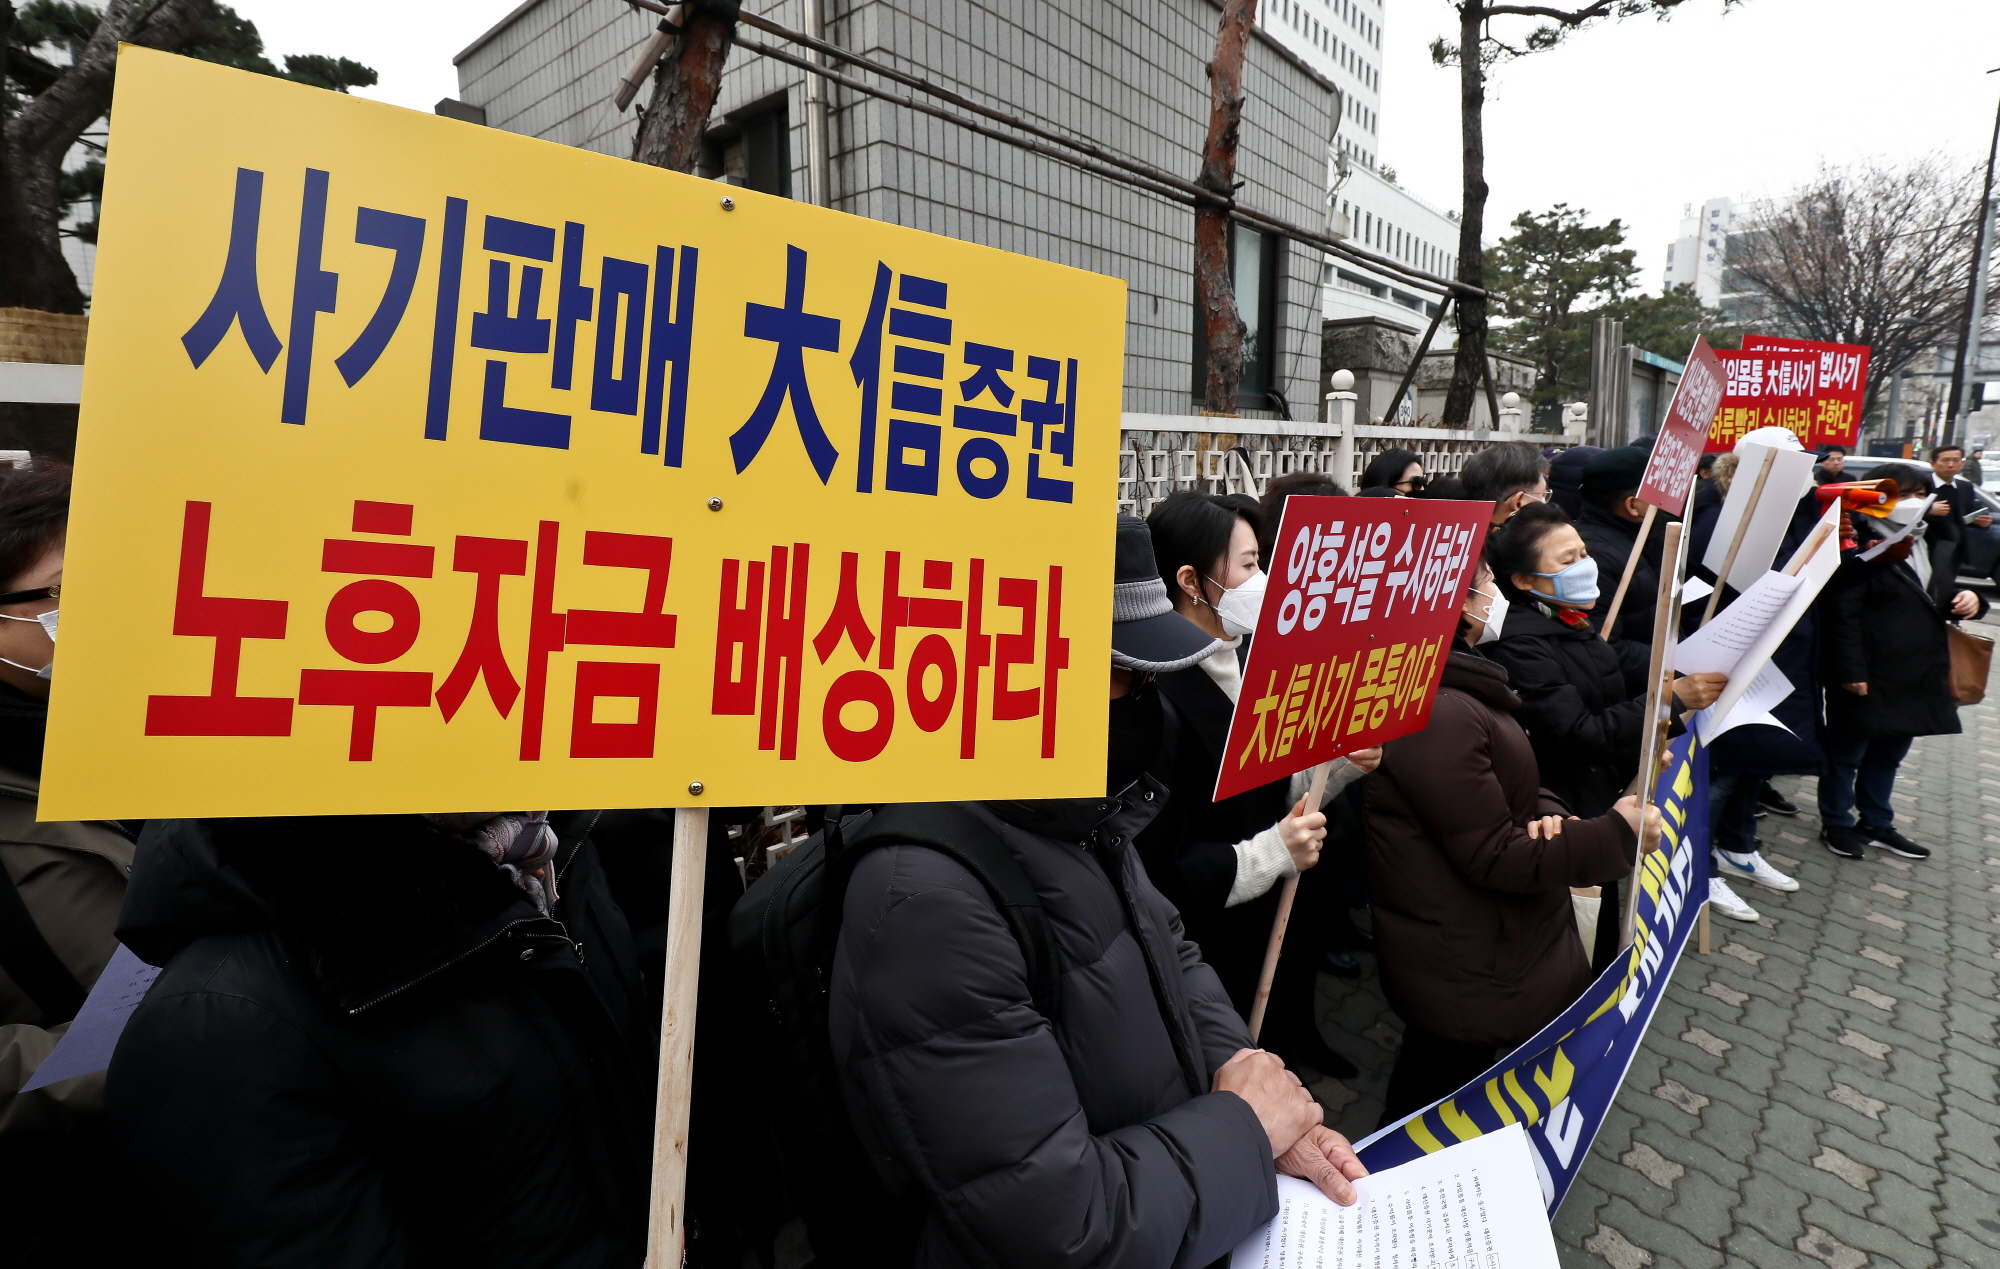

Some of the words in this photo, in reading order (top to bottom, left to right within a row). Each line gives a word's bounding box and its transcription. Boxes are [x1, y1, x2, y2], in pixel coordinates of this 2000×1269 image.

[181, 167, 699, 468] 사기판매
[729, 243, 1078, 504] 大信증권
[1765, 360, 1815, 397] 大信사기
[1809, 349, 1861, 391] 법사기
[1709, 407, 1760, 444] 하루빨리
[1277, 521, 1391, 635] 양홍석을
[1385, 523, 1477, 618] 수사하라
[145, 500, 677, 762] 노후자금
[711, 543, 1069, 762] 배상하라
[1239, 650, 1360, 770] 大信사기
[1347, 635, 1443, 735] 몸통이다
[1484, 1228, 1493, 1252] 대신증권
[1488, 1255, 1496, 1269] 수사
